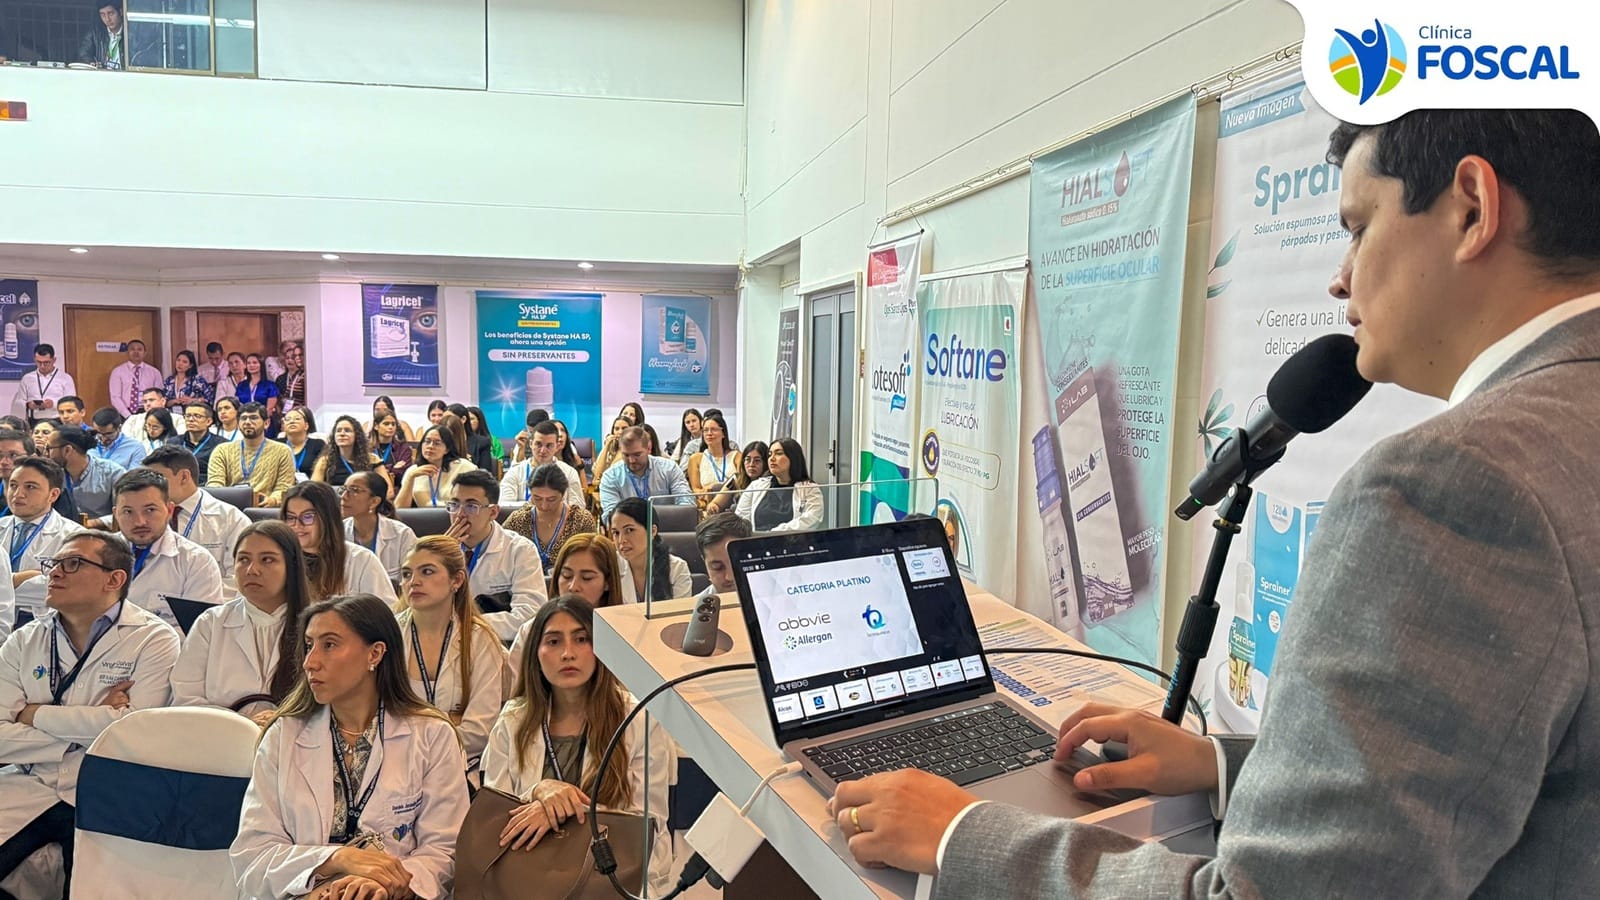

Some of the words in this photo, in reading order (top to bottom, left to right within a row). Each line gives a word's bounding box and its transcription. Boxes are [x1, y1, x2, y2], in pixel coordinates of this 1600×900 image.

[1225, 109, 1255, 129] Nueva
[1256, 95, 1295, 116] Imagen
[1254, 163, 1340, 215] Sprai
[1254, 219, 1285, 235] Solución
[1286, 215, 1326, 231] espumosa
[1327, 213, 1338, 226] pa
[1041, 247, 1076, 268] AVANCE
[1077, 244, 1089, 261] EN
[1091, 225, 1160, 258] HIDRATACIÓN
[1280, 232, 1318, 250] párpados
[1319, 232, 1325, 245] y
[1041, 274, 1051, 290] DE
[1053, 273, 1064, 289] LA
[1065, 263, 1117, 286] SUPERFICIE
[1118, 255, 1160, 279] OCULAR
[381, 295, 423, 308] Lagricel
[1266, 310, 1307, 327] Genera
[1310, 312, 1334, 326] una
[497, 331, 532, 339] beneficios
[1265, 337, 1306, 355] delicad
[502, 351, 516, 359] SIN
[517, 352, 576, 360] PRESERVANTES
[926, 333, 1006, 382] Softane
[1131, 366, 1150, 377] GOTA
[1118, 409, 1153, 423] PROTEGE
[1154, 412, 1165, 425] LA
[1117, 426, 1160, 443] SUPERFICIE
[786, 581, 836, 596] CATEGORIA
[836, 575, 871, 588] PLATINO
[778, 612, 832, 632] abbvie
[797, 632, 833, 645] Allergan
